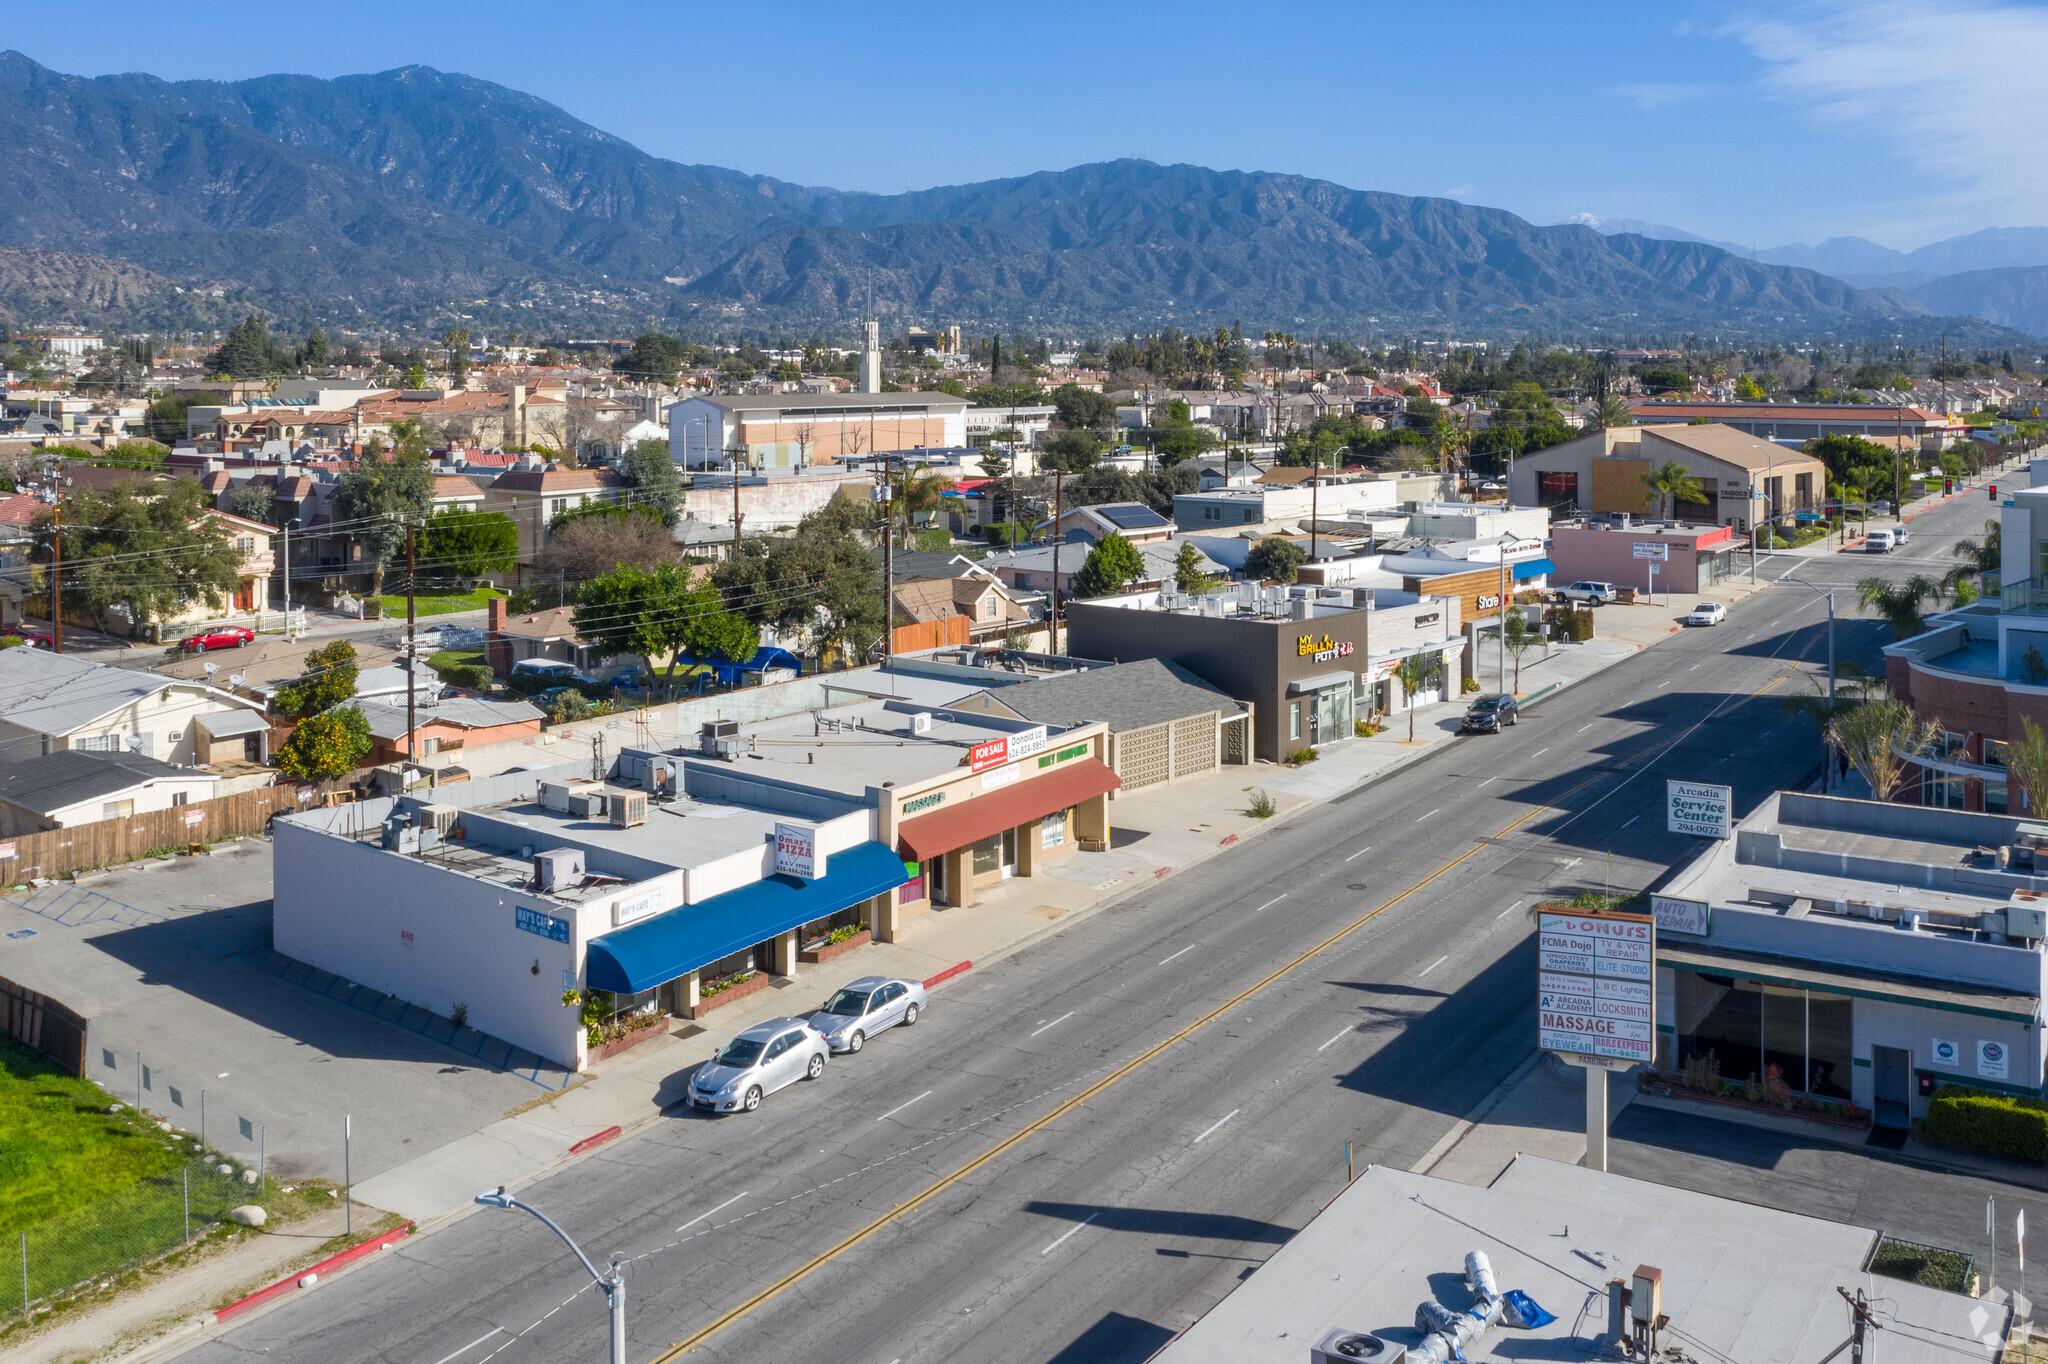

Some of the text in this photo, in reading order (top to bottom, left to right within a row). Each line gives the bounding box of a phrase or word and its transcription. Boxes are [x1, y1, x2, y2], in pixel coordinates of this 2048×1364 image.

[1299, 634, 1313, 645] MY
[1315, 650, 1332, 662] POT
[1012, 730, 1034, 746] Donald
[976, 742, 1004, 760] FOR SALE
[1677, 786, 1719, 799] Arcadia
[1671, 798, 1725, 814] Service
[1673, 809, 1722, 824] Center
[1677, 823, 1720, 835] 294-0072
[779, 834, 812, 847] Omar's
[778, 842, 812, 858] PIZZA
[621, 900, 648, 916] MAY'S CAFE
[1655, 902, 1687, 915] AUTO
[518, 908, 535, 924] MAY'S
[1656, 914, 1695, 931] REPAIR
[1566, 921, 1647, 939] DONUTS
[1542, 937, 1592, 952] FCMA Dojo
[1601, 940, 1612, 948] TV
[1627, 943, 1645, 951] VCR
[1546, 953, 1589, 962] UPHOLSTERY
[1606, 949, 1639, 959] REPAIR
[1545, 964, 1590, 973] ACCESSORIES
[1549, 959, 1586, 967] DRAPERIES
[1621, 964, 1648, 976] STUDIO
[1621, 985, 1649, 996] Lighting
[1556, 1003, 1592, 1013] ACADEMY
[1557, 997, 1591, 1006] ARCADIA
[1597, 1003, 1648, 1018] LOCKSMITH
[1543, 1014, 1615, 1034] MASSAGE
[1624, 1022, 1647, 1030] Arcadia
[1552, 1032, 1581, 1041] ARCADIA
[1630, 1031, 1641, 1039] Spa
[1542, 1038, 1592, 1052] EYEWEAR
[1596, 1037, 1648, 1052] NAILS EXPRESS
[1578, 1056, 1608, 1067] PARKING
